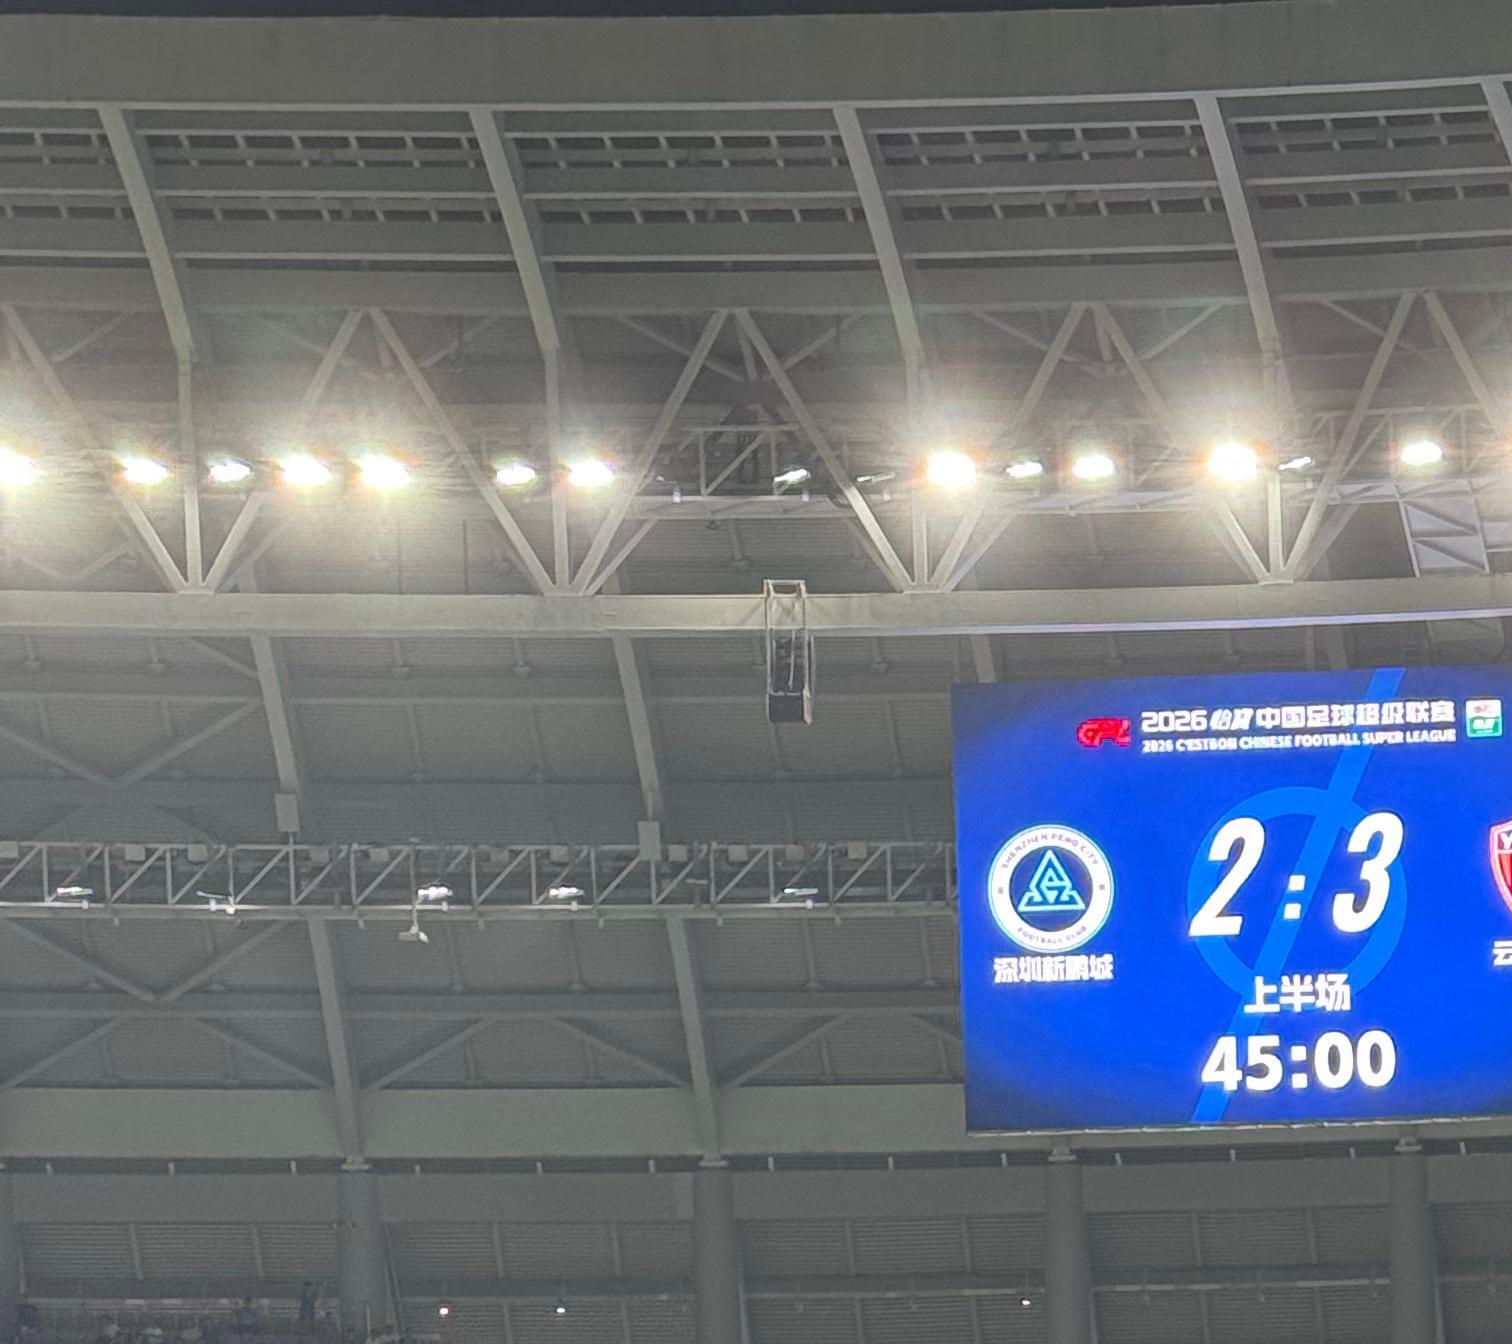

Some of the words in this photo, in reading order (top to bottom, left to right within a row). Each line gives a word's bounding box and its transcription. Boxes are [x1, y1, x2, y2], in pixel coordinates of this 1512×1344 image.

[1239, 736, 1292, 750] CHINESE
[1295, 733, 1360, 748] FOOTBALL
[1362, 731, 1404, 745] SUPER
[1405, 728, 1457, 743] LEAGUE
[993, 954, 1114, 984] 深圳新鹏城
[1244, 973, 1351, 1014] 上半场
[1200, 1029, 1397, 1092] 45:00
